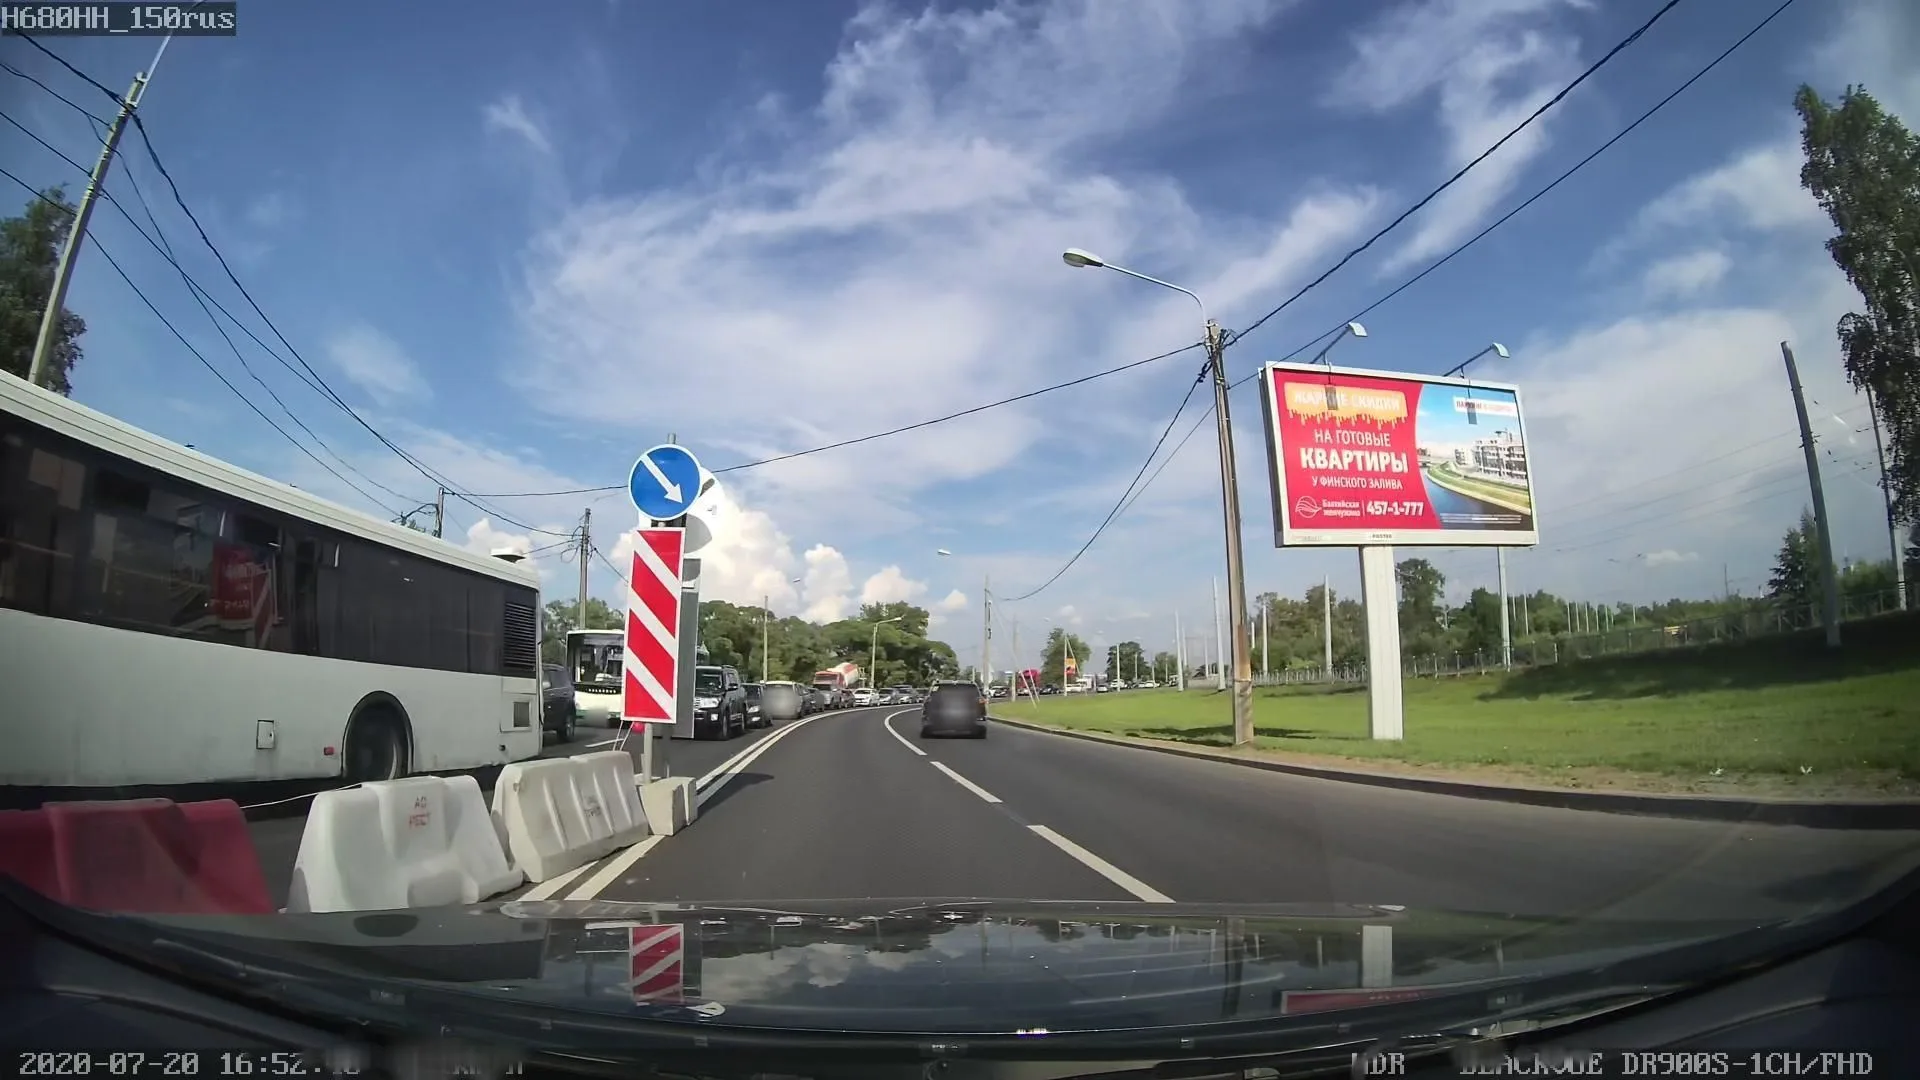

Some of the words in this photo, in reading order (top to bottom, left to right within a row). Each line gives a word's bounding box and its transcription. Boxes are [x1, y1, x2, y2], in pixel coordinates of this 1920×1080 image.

[1313, 429, 1333, 444] НА
[1335, 429, 1392, 447] ГОТОВЫЕ
[1299, 447, 1409, 473] КВАРТИРЫ
[1311, 476, 1318, 487] У
[1320, 476, 1367, 489] ФИНСКОГО
[1369, 478, 1404, 490] ЗАЛИВА
[1366, 500, 1424, 516] 457-1-777
